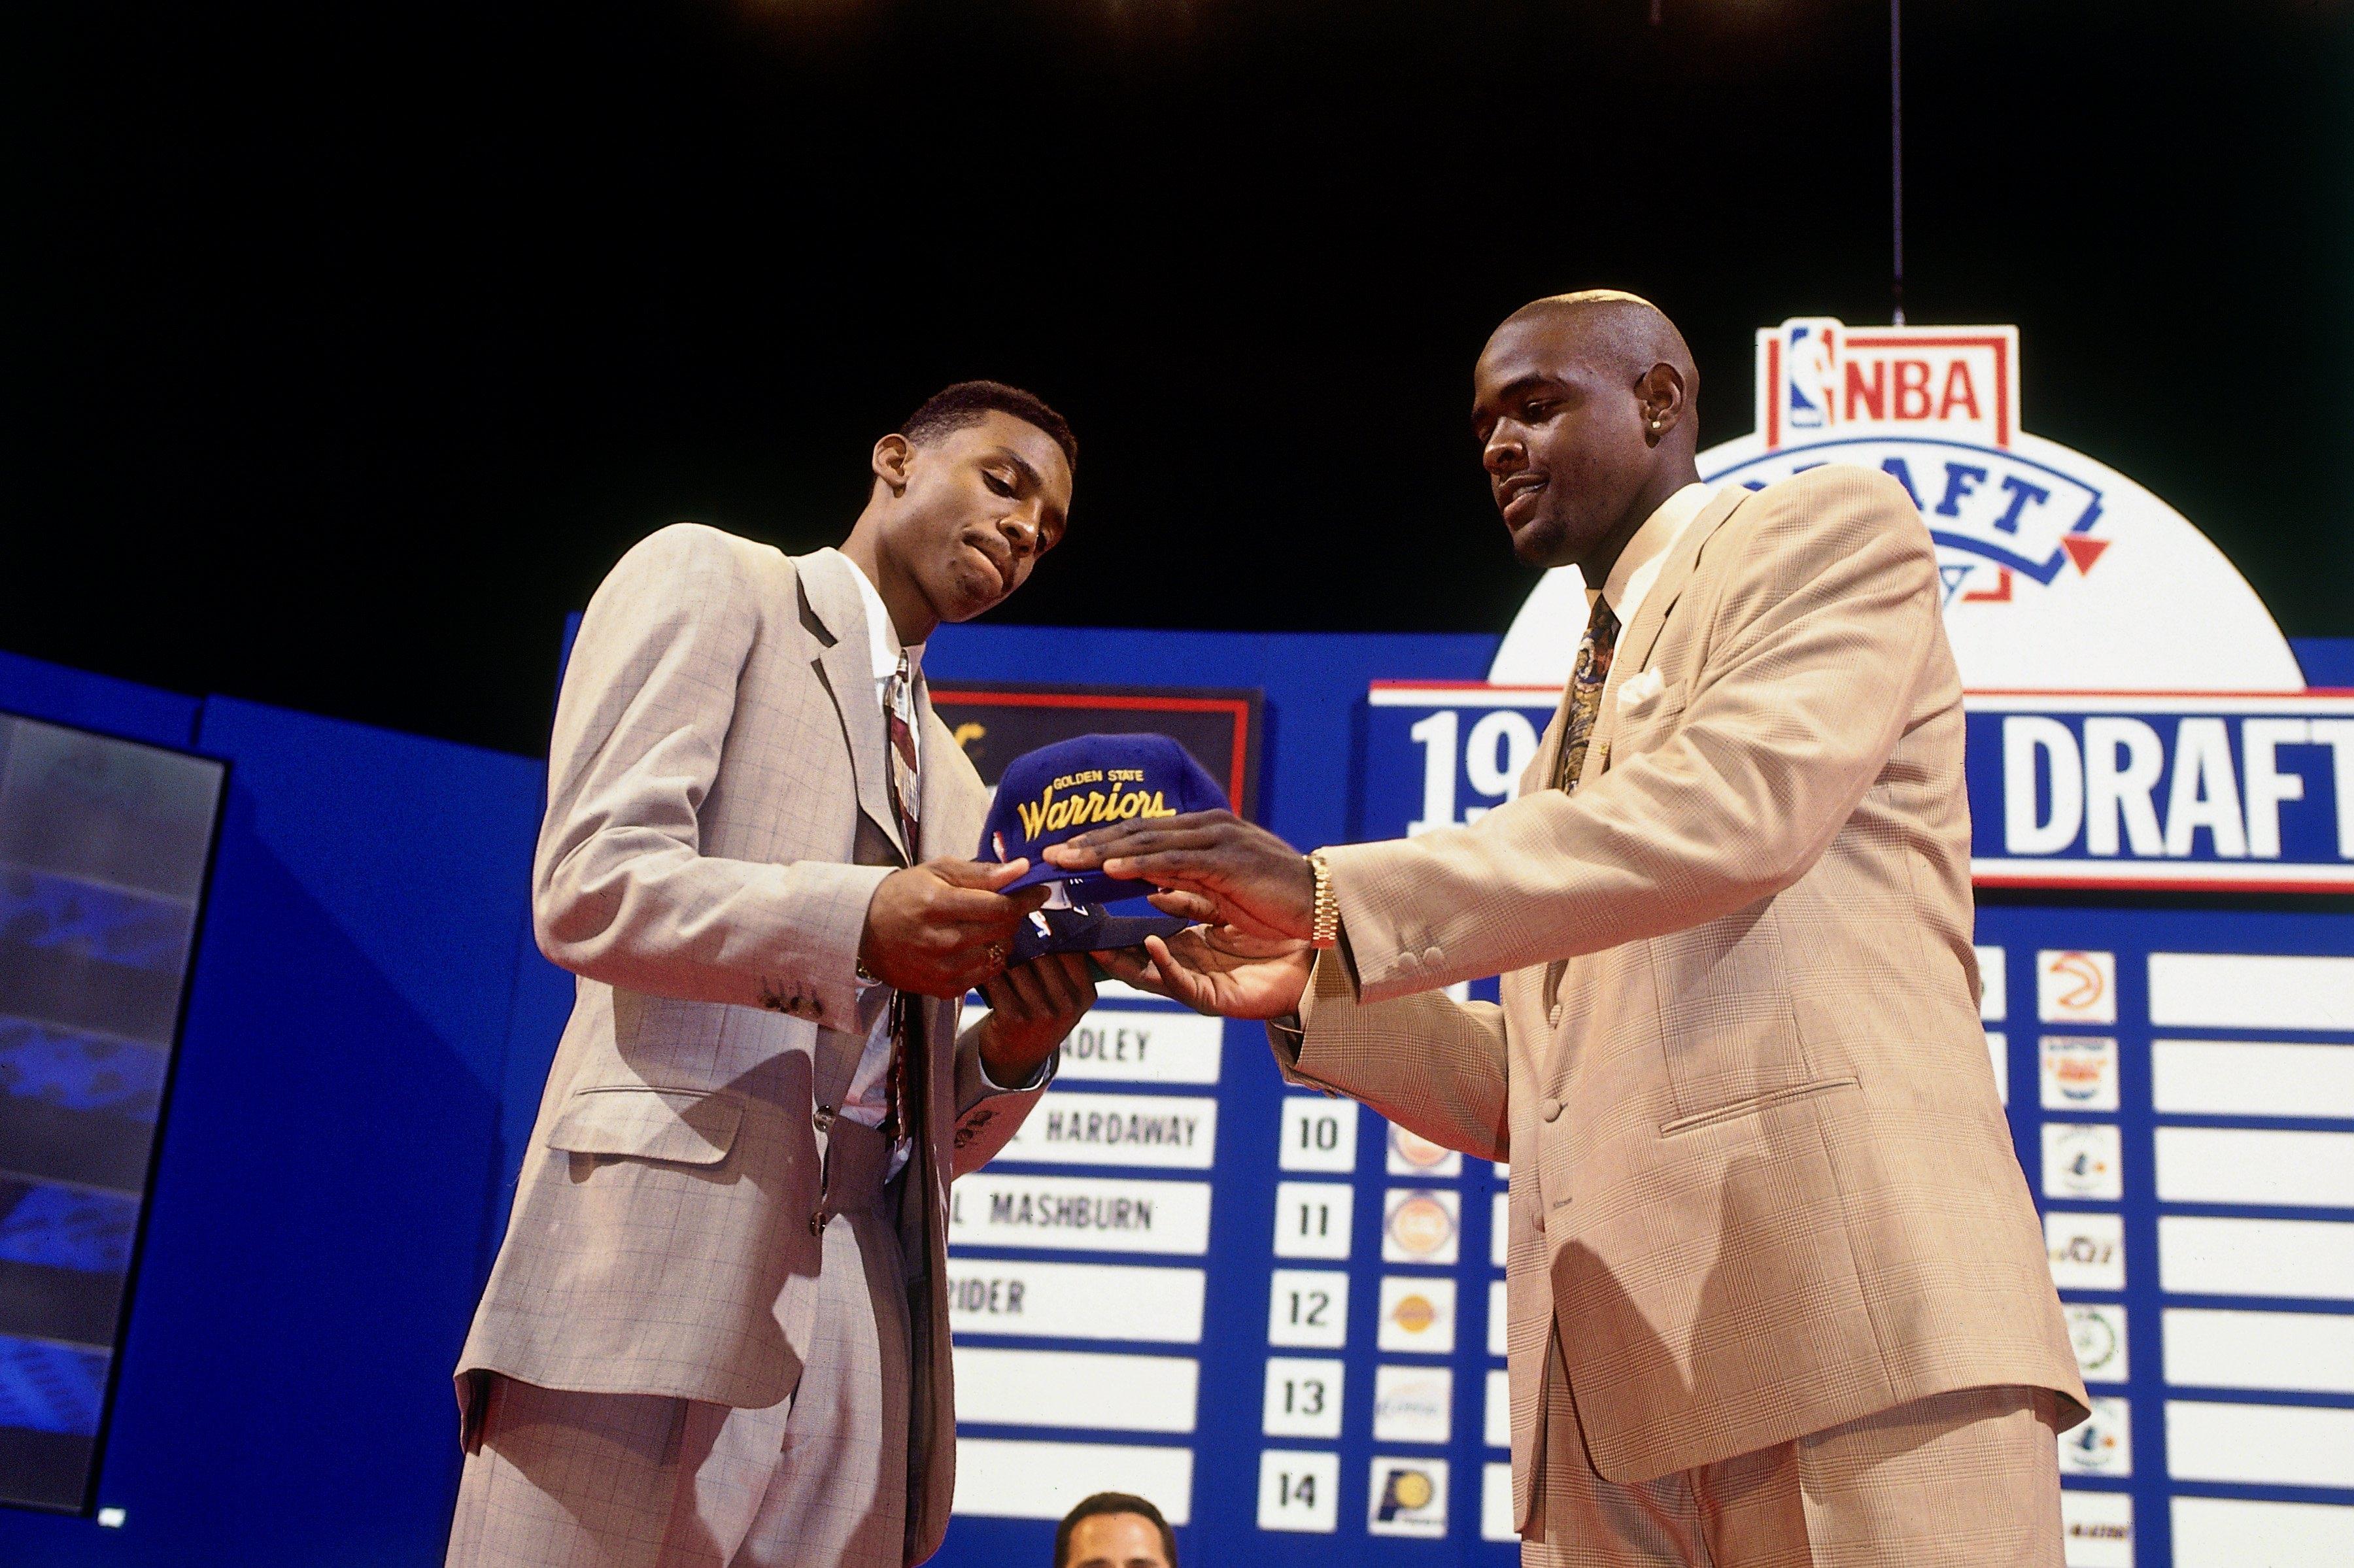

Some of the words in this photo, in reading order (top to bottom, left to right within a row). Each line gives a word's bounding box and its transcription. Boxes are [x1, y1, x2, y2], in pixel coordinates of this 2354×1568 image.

[1844, 359, 1981, 422] NBA
[1053, 770, 1103, 790] GOLDEN
[1108, 769, 1144, 782] STATE
[1407, 710, 1539, 838] 19
[2003, 715, 2354, 859] DRAFT
[1017, 782, 1177, 842] Warriors
[1061, 1027, 1151, 1062] ADLEY
[1046, 1110, 1197, 1148] HARDAWAY
[1300, 1116, 1339, 1151] 10
[989, 1191, 1153, 1231] MASHBURN
[1300, 1203, 1328, 1237] 11
[1290, 1291, 1330, 1327] 12
[1284, 1380, 1325, 1415] 13
[1280, 1473, 1316, 1508] 14
